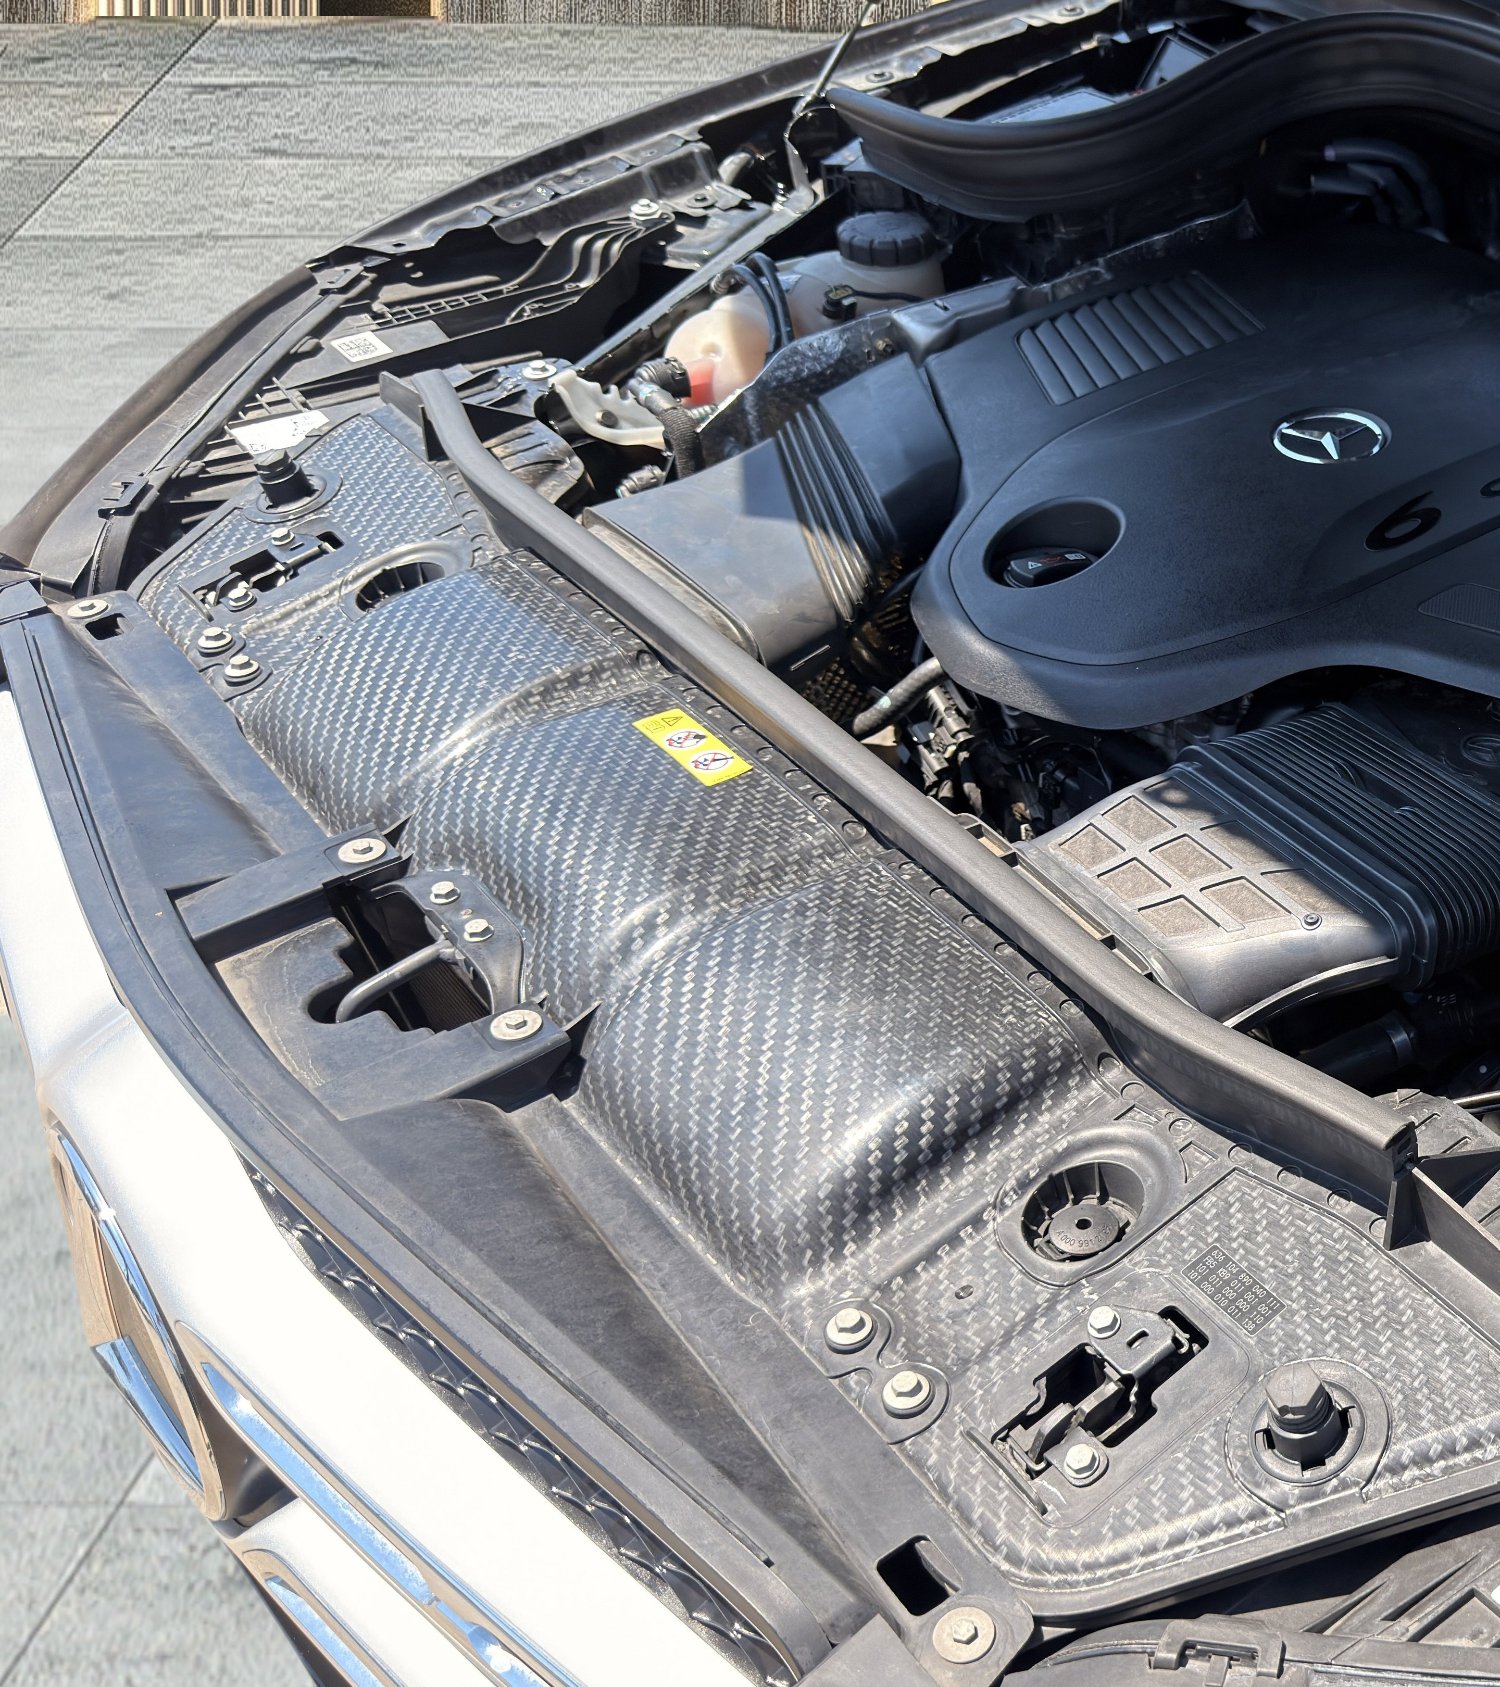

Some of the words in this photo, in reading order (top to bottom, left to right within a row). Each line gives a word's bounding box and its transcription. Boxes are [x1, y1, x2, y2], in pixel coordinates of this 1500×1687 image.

[1363, 490, 1442, 552] 6
[1060, 1234, 1076, 1247] 000
[1188, 1270, 1201, 1282] 101
[1201, 1282, 1214, 1294] 000
[1214, 1294, 1228, 1306] 010
[1228, 1306, 1241, 1318] 011
[1242, 1319, 1255, 1330] 138
[1196, 1264, 1209, 1275] 101
[1209, 1275, 1222, 1287] 011
[1222, 1287, 1236, 1299] 000
[1236, 1299, 1250, 1311] 000
[1250, 1312, 1263, 1323] 110
[1212, 1250, 1225, 1261] 636
[1226, 1262, 1239, 1273] 104
[1239, 1273, 1252, 1285] 890
[1253, 1285, 1266, 1297] 040
[1267, 1298, 1279, 1310] 111
[1231, 1280, 1244, 1292] 011
[1244, 1292, 1258, 1304] 001
[1258, 1304, 1272, 1316] 001
